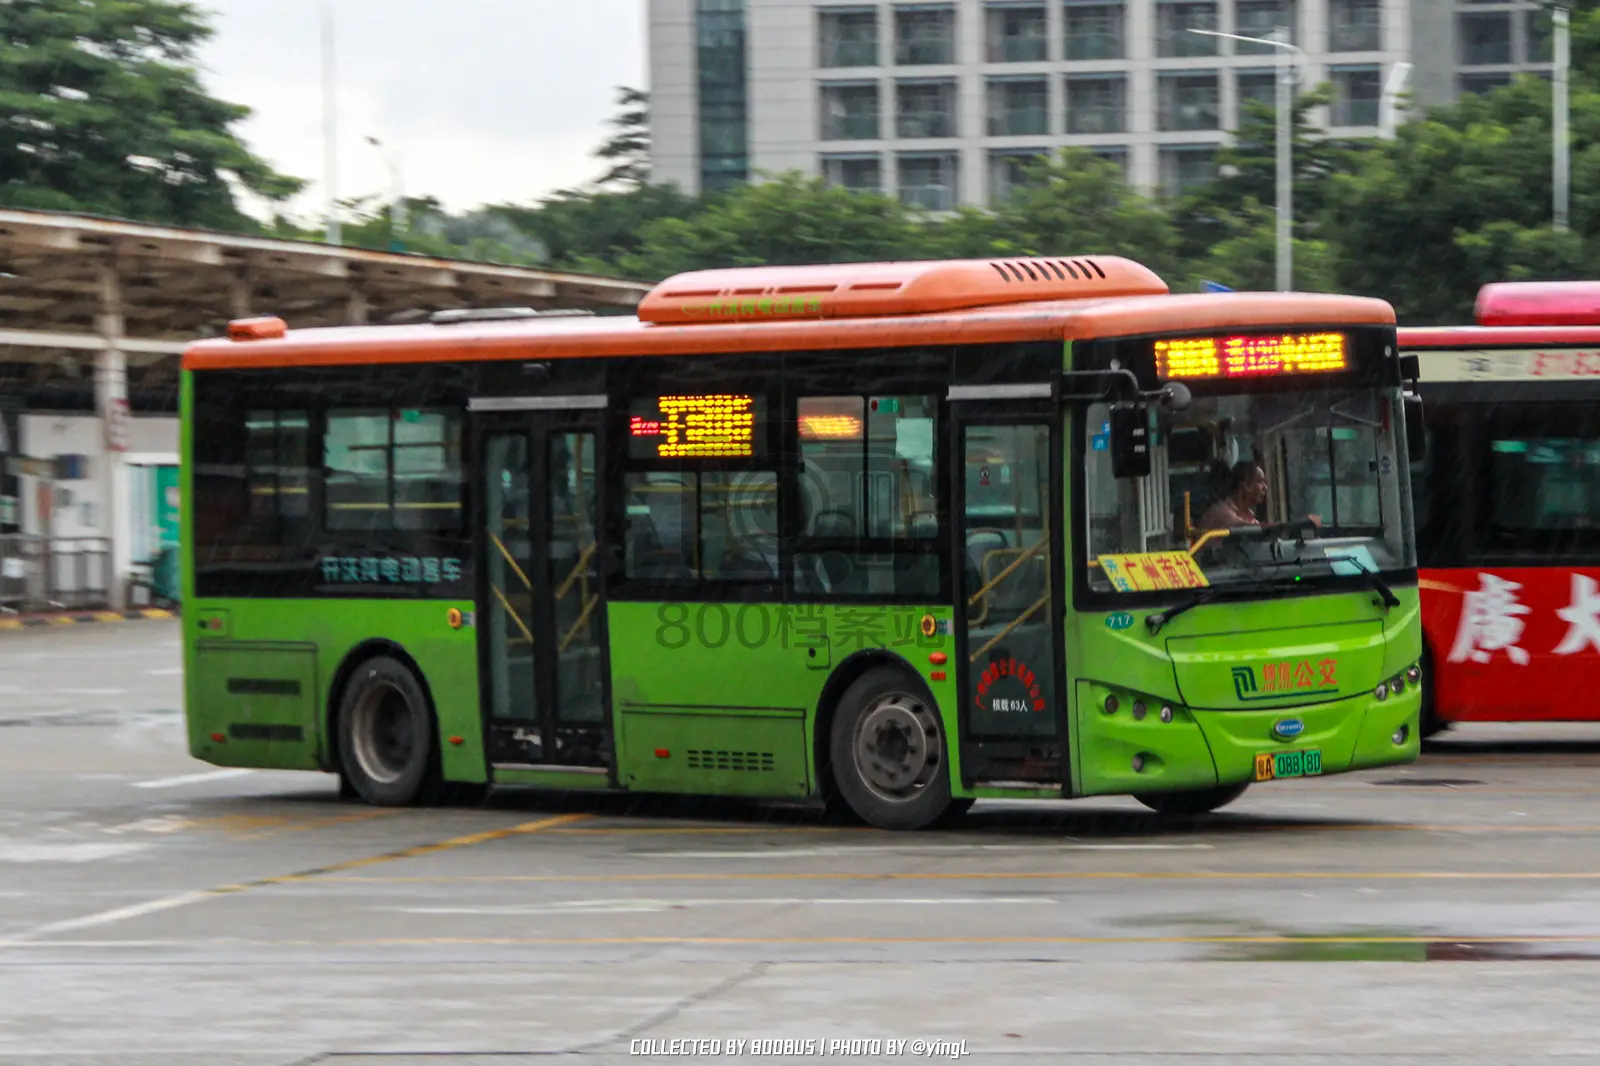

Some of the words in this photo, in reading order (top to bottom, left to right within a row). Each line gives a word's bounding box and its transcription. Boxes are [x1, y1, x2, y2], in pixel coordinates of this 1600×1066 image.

[1124, 554, 1205, 591] 广州南站
[1108, 614, 1131, 628] 717
